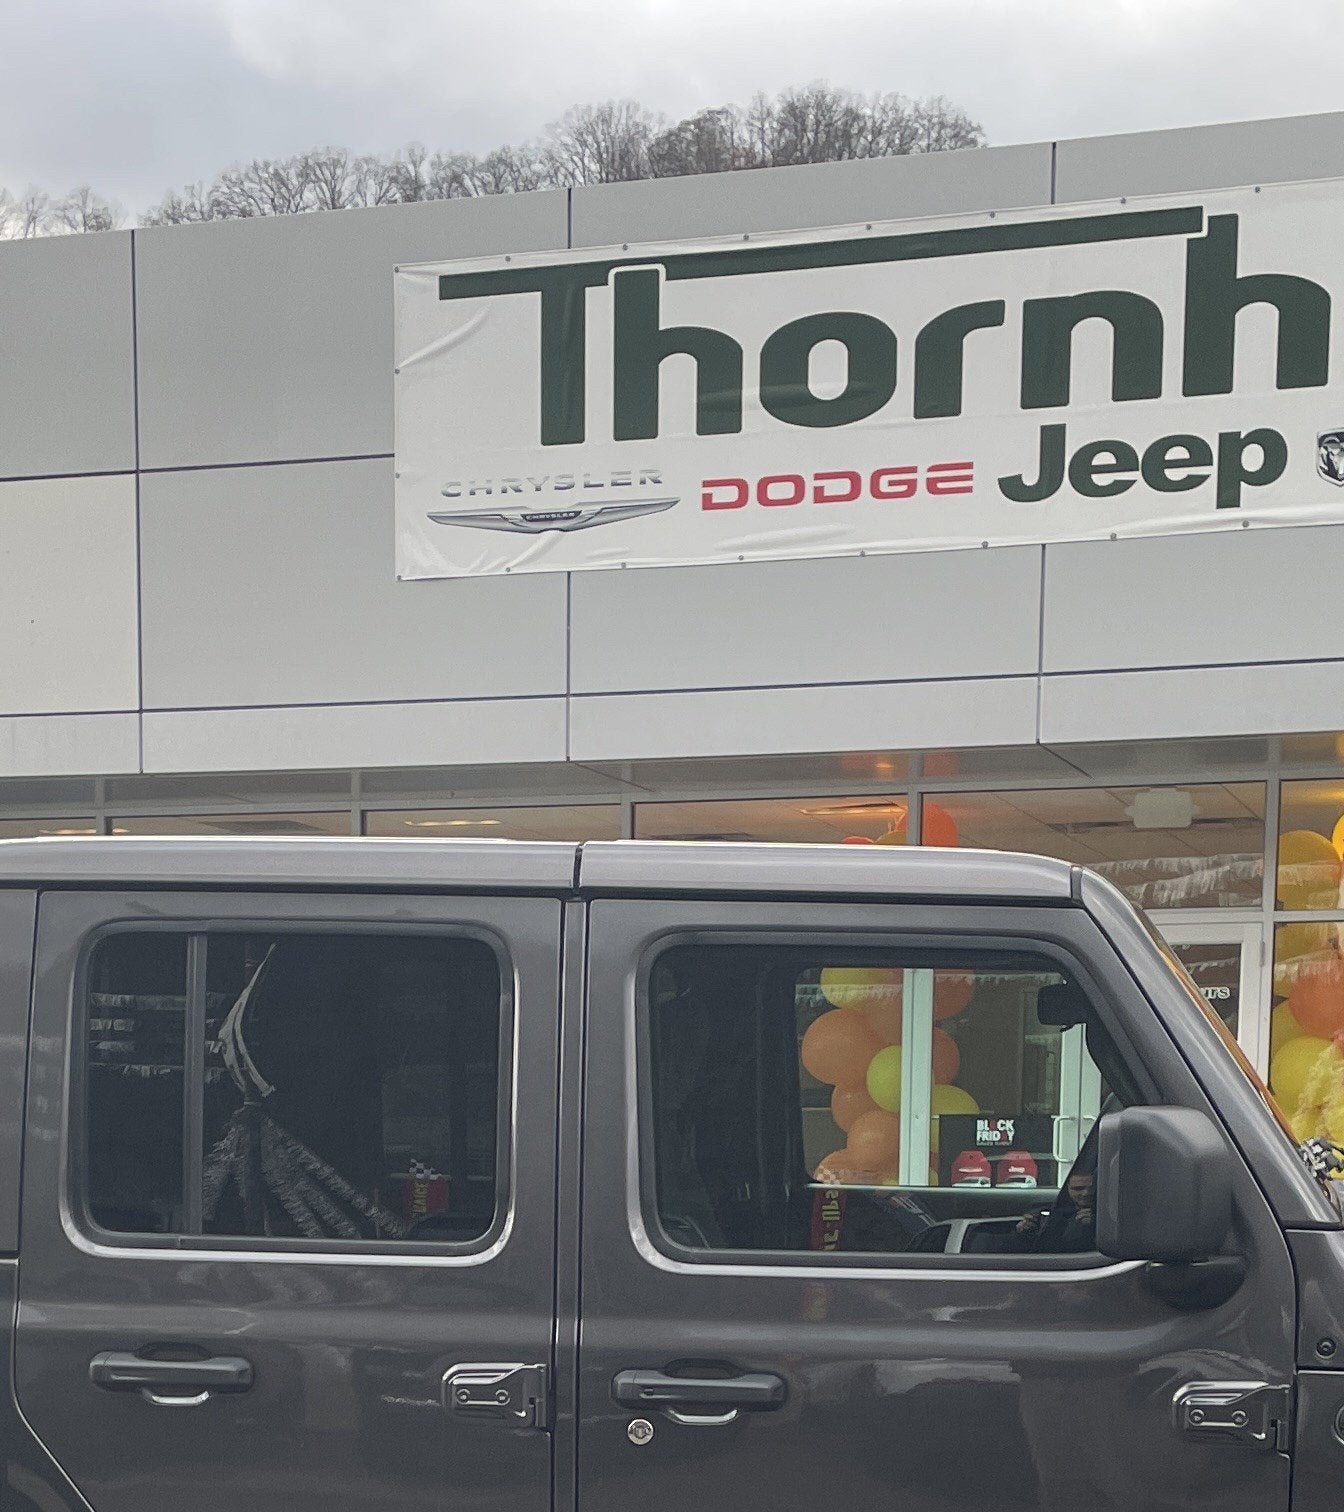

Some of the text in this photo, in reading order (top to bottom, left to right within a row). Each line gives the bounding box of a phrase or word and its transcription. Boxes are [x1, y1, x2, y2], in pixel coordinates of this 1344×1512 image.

[440, 468, 663, 498] CHRYSLER
[702, 462, 974, 511] DODGE
[997, 423, 1289, 510] Jeep
